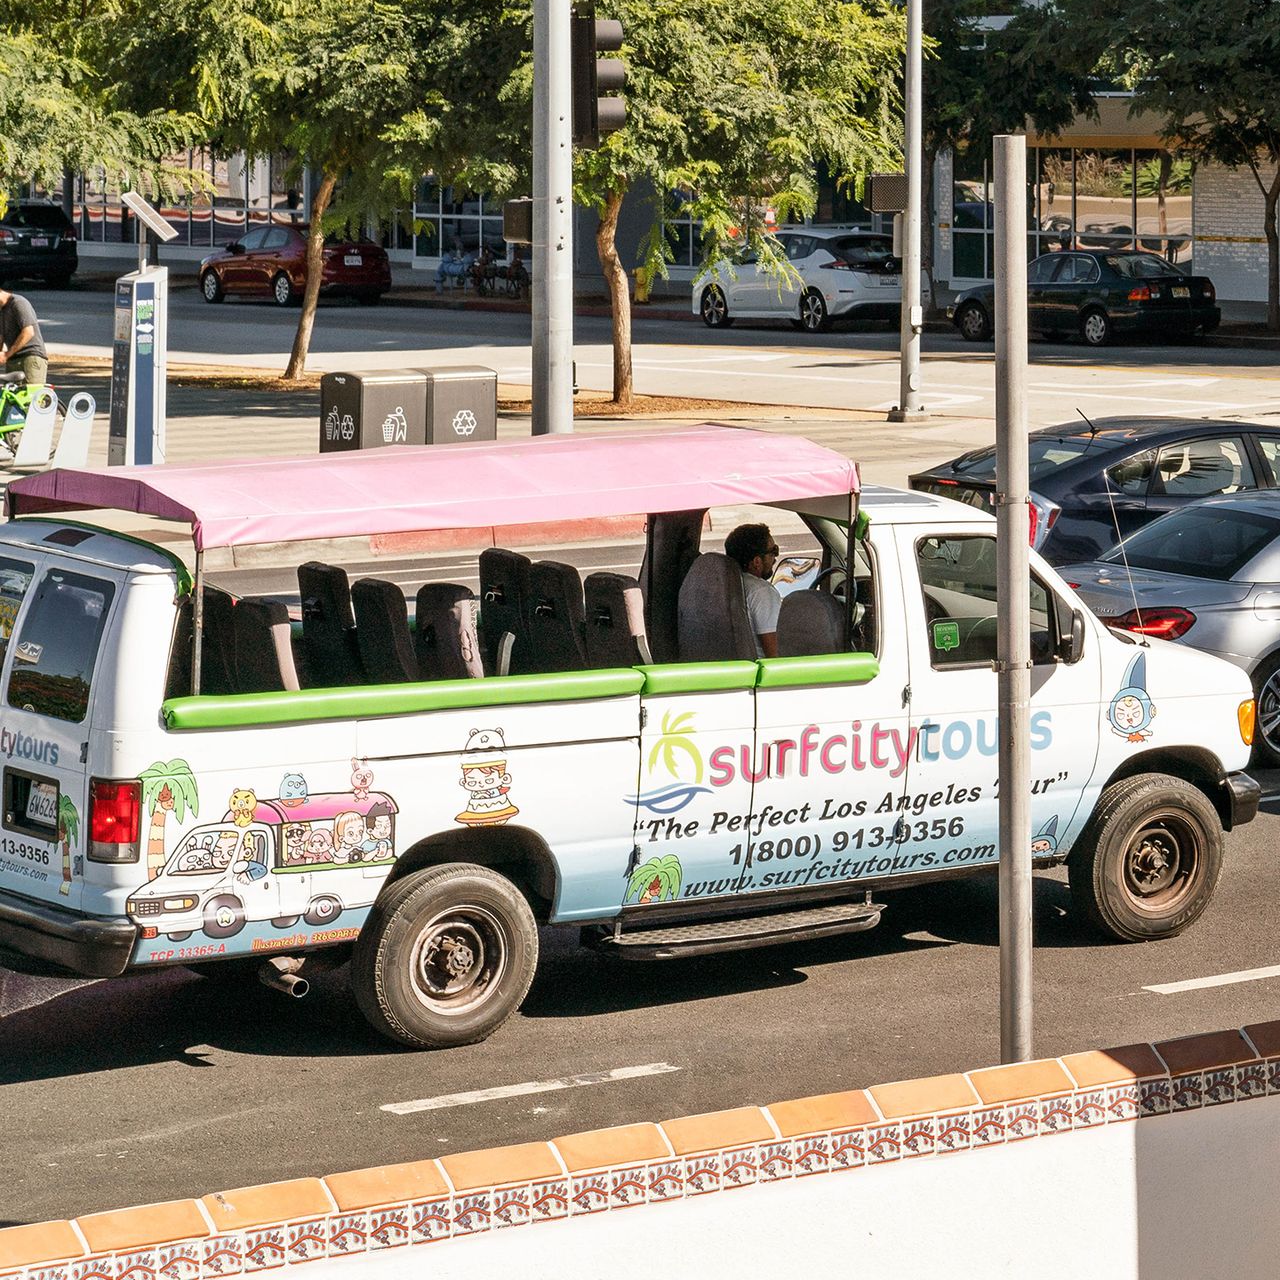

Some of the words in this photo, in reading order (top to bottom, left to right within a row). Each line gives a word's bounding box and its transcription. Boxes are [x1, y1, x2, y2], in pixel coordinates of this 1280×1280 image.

[709, 710, 1052, 787] surfcitytous
[708, 801, 811, 836] Perfect
[819, 798, 867, 820] Los
[875, 784, 981, 816] Angeles
[729, 834, 821, 868] 1(800)
[832, 817, 964, 853] 913-9356
[684, 843, 995, 897] www.surfcitytours.com
[150, 949, 174, 961] TCP
[177, 943, 225, 958] 33365-A
